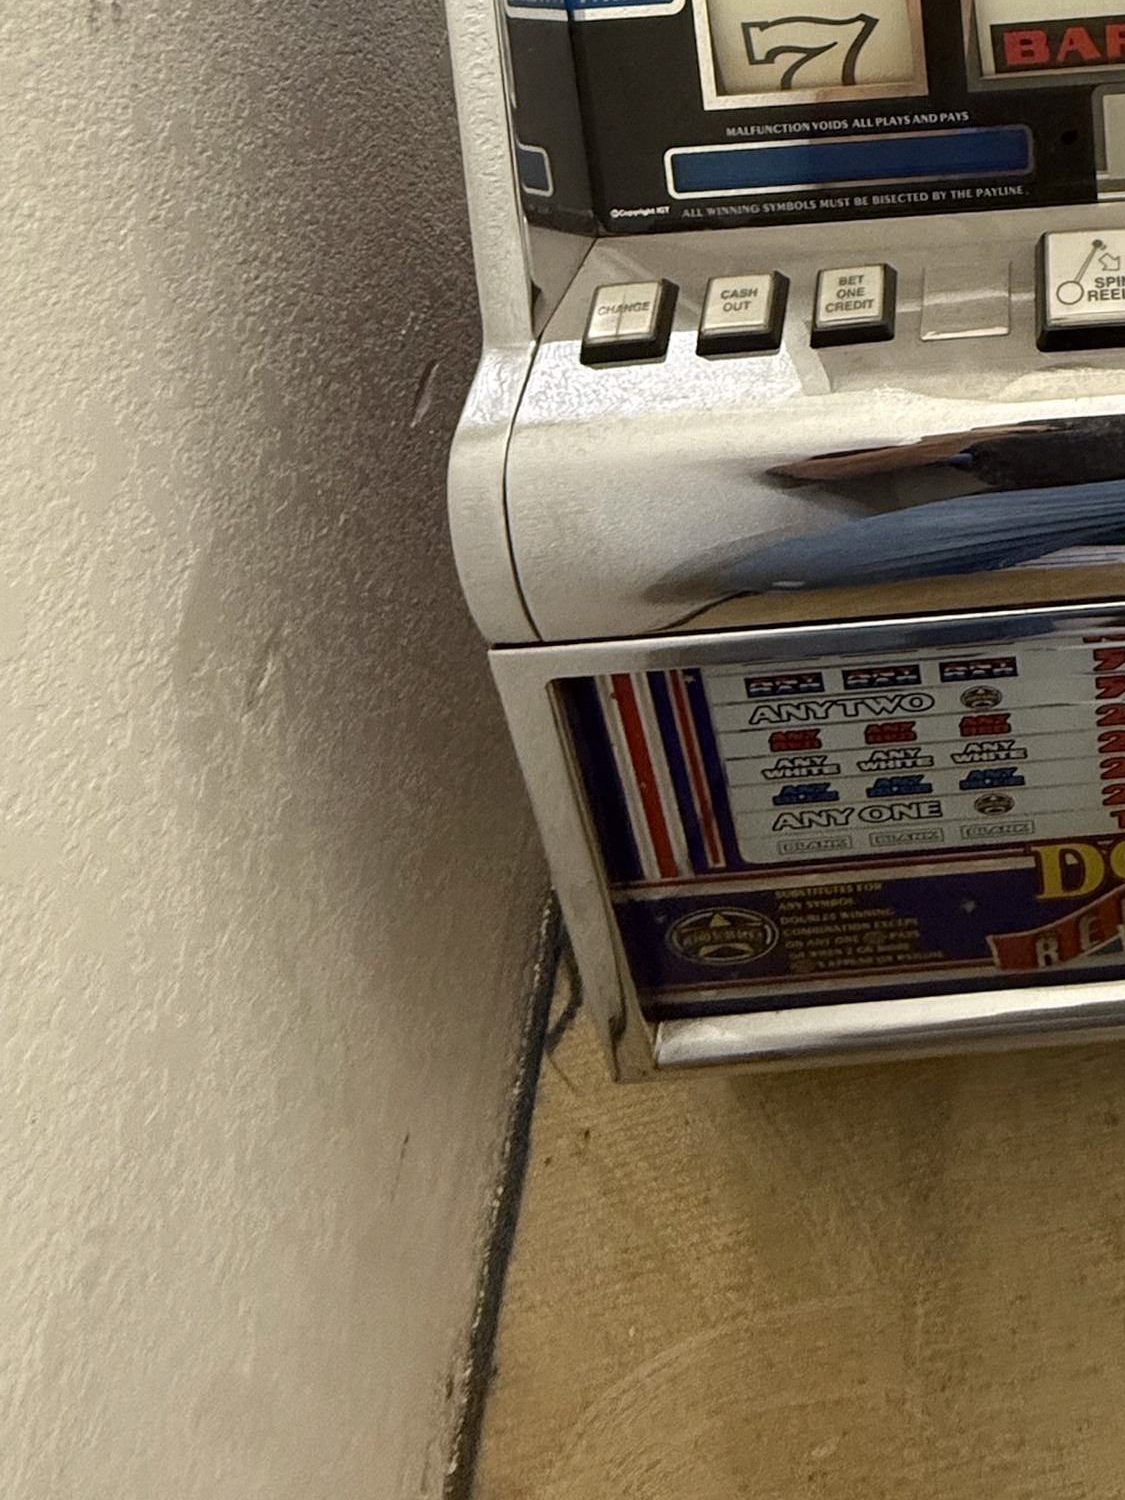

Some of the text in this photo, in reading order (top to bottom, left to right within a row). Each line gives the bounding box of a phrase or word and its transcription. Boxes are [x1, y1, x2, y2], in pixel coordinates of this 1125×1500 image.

[741, 13, 879, 90] 7
[727, 111, 969, 137] MALFUNCTION VOIDS ALL PLAYS AND PAYS
[682, 208, 703, 218] ALL
[707, 204, 759, 216] WINNING
[762, 200, 816, 213] SYMBOLS
[819, 197, 849, 208] MUST
[854, 196, 868, 206] BE
[872, 192, 928, 205] BISECTED
[932, 190, 946, 201] BY
[950, 189, 972, 198] THE
[839, 275, 864, 286] BET
[721, 288, 758, 300] CASH
[837, 286, 865, 298] ONE
[598, 301, 650, 316] CHANGE
[723, 300, 752, 312] OUT
[825, 299, 875, 313] CREDIT
[776, 756, 827, 770] ANY
[762, 764, 840, 780] WHITE
[773, 801, 942, 831] ANY ONE
